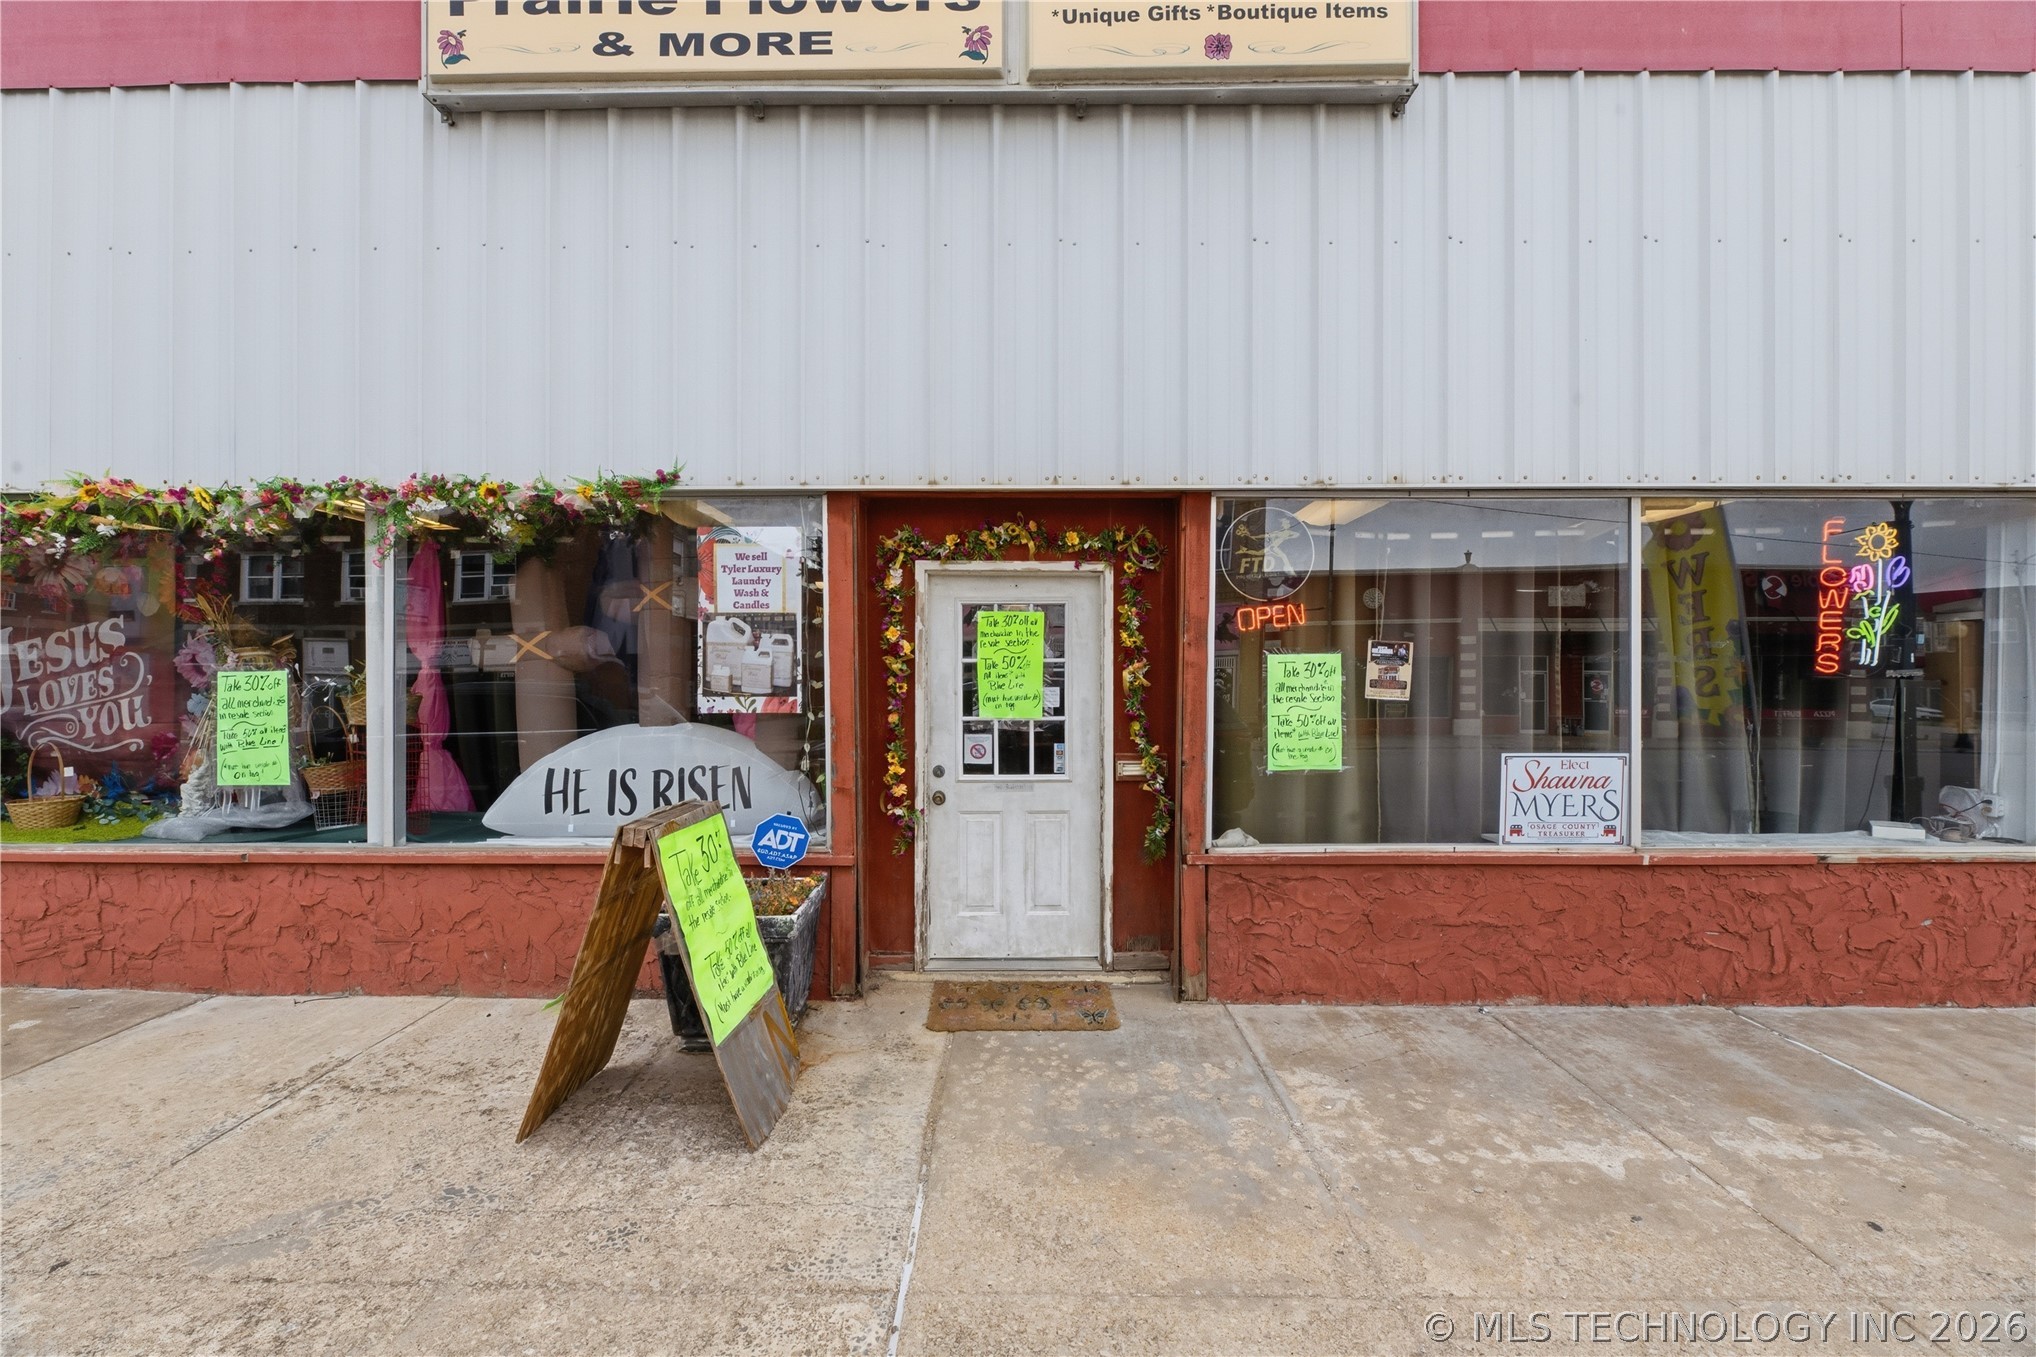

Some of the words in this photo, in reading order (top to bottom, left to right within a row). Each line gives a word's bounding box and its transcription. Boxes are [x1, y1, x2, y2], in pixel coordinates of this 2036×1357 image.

[1148, 5, 1201, 21] Gifts
[1326, 3, 1388, 19] Items
[592, 32, 634, 57] &
[659, 31, 833, 57] MORE
[735, 552, 750, 561] We
[752, 552, 767, 561] sell
[1239, 556, 1275, 574] FTD
[721, 564, 747, 575] Tyler
[747, 564, 782, 575] Luxury
[732, 577, 771, 587] Laundry
[734, 588, 759, 598] Wash
[761, 589, 769, 597] &
[1815, 516, 1848, 674] FLOWERS
[733, 601, 770, 609] Candles
[981, 615, 1000, 627] Take
[1002, 614, 1019, 627] 30%
[1236, 602, 1306, 632] OPEN
[1026, 627, 1039, 637] the
[980, 657, 999, 670] Take
[1002, 655, 1027, 670] 50%
[1278, 661, 1300, 678] Take
[1303, 661, 1326, 679] 30%
[17, 665, 115, 716] LOVES
[222, 675, 241, 692] Take
[243, 675, 270, 691] 30%
[221, 697, 236, 709] all
[77, 695, 152, 740] YOU
[1271, 714, 1293, 727] Take
[1296, 714, 1317, 728] 50%
[1560, 759, 1589, 770] Elect
[1512, 760, 1613, 792] Shawna
[543, 766, 591, 816] HE
[607, 767, 637, 816] IS
[651, 765, 752, 812] RISEN
[1510, 789, 1620, 822] MYERS
[757, 829, 805, 852] ADT
[668, 849, 702, 892] Take
[689, 914, 700, 932] the
